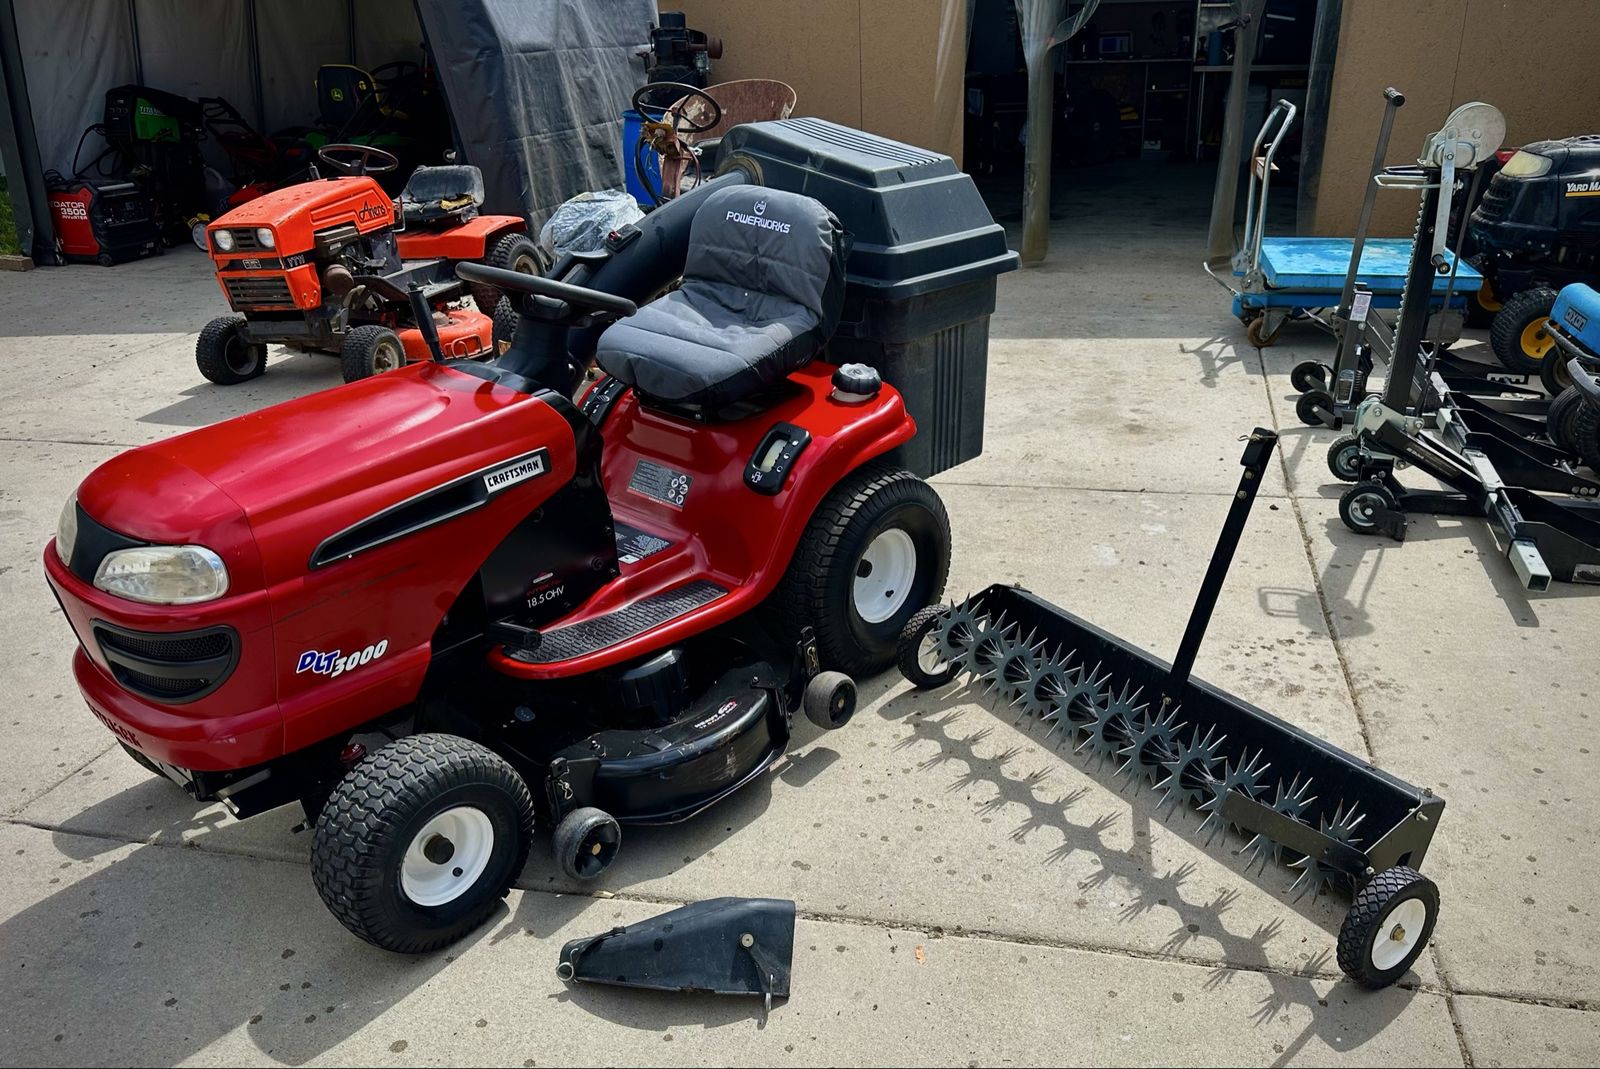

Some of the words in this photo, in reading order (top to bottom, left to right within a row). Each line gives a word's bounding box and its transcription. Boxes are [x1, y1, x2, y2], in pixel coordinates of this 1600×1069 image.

[1566, 182, 1589, 192] YARD
[60, 207, 87, 216] 3500
[726, 210, 791, 234] POWERWORKS
[487, 459, 540, 487] CRAFTSMAN
[527, 592, 546, 609] 18.5
[545, 584, 565, 601] OHV
